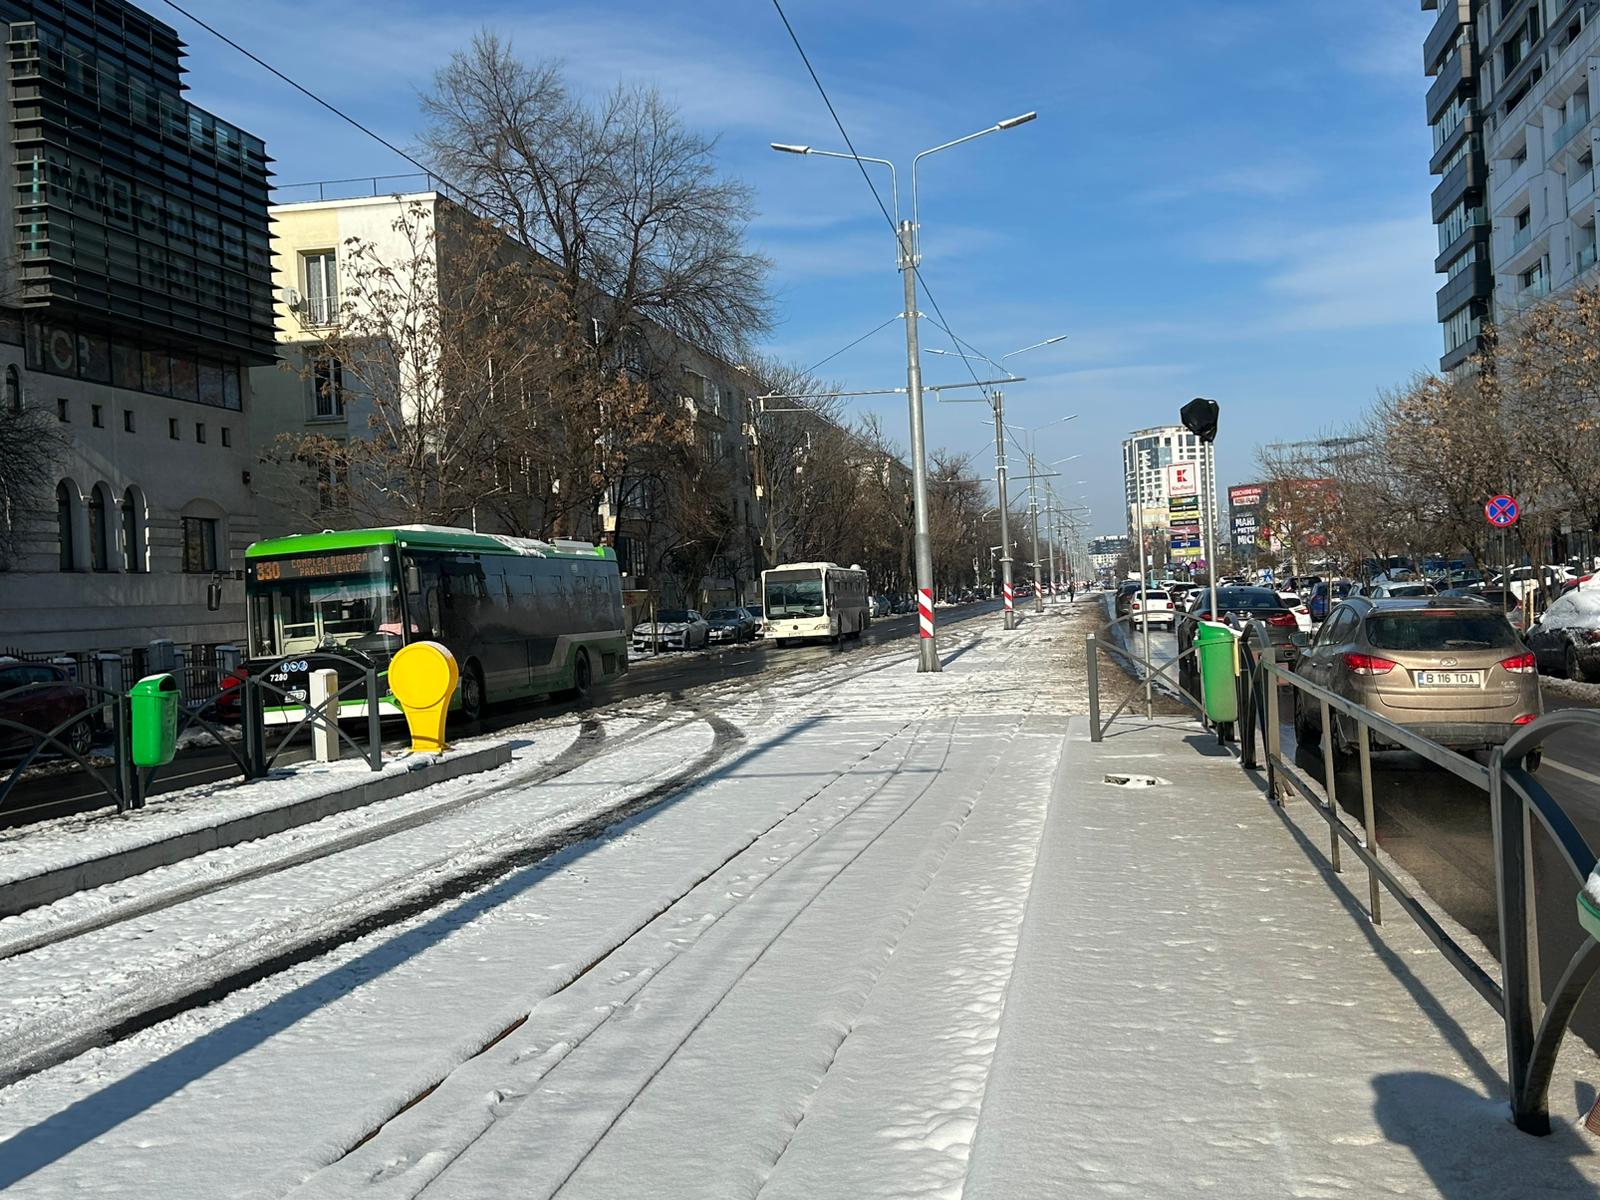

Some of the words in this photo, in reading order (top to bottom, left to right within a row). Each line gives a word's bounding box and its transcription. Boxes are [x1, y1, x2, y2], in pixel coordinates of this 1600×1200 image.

[256, 561, 280, 580] 330
[300, 566, 330, 577] PARCUL
[270, 673, 288, 682] 7280
[1426, 674, 1434, 683] B
[1437, 674, 1451, 683] 116
